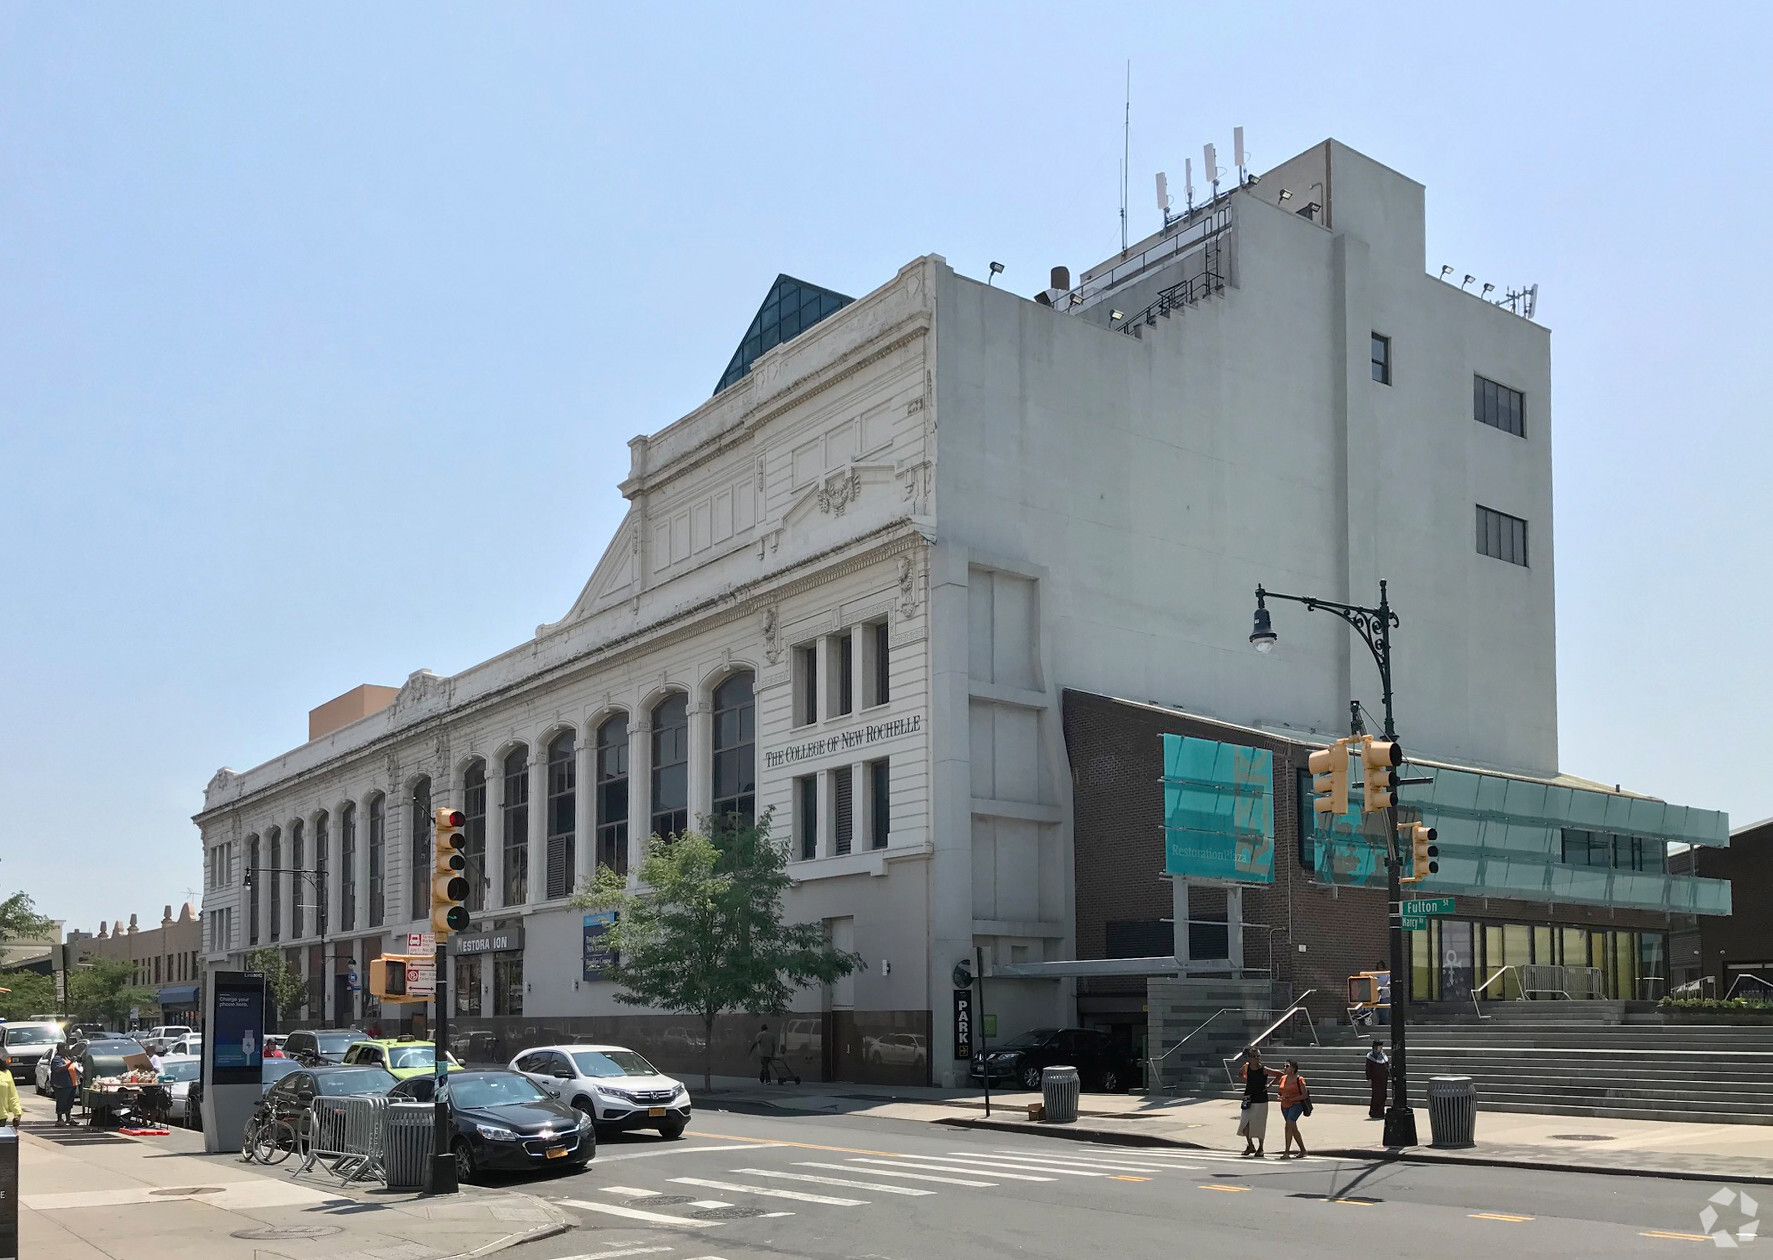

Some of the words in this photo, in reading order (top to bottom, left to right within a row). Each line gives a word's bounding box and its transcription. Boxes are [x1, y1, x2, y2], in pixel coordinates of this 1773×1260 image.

[766, 751, 784, 768] THE
[785, 740, 825, 763] COLLEGE
[827, 736, 840, 752] OF
[841, 729, 864, 749] NEW
[866, 715, 921, 743] ROCHELLE
[1407, 901, 1438, 914] Fulton
[1402, 917, 1418, 930] Marcy
[958, 1000, 969, 1043] PARK
